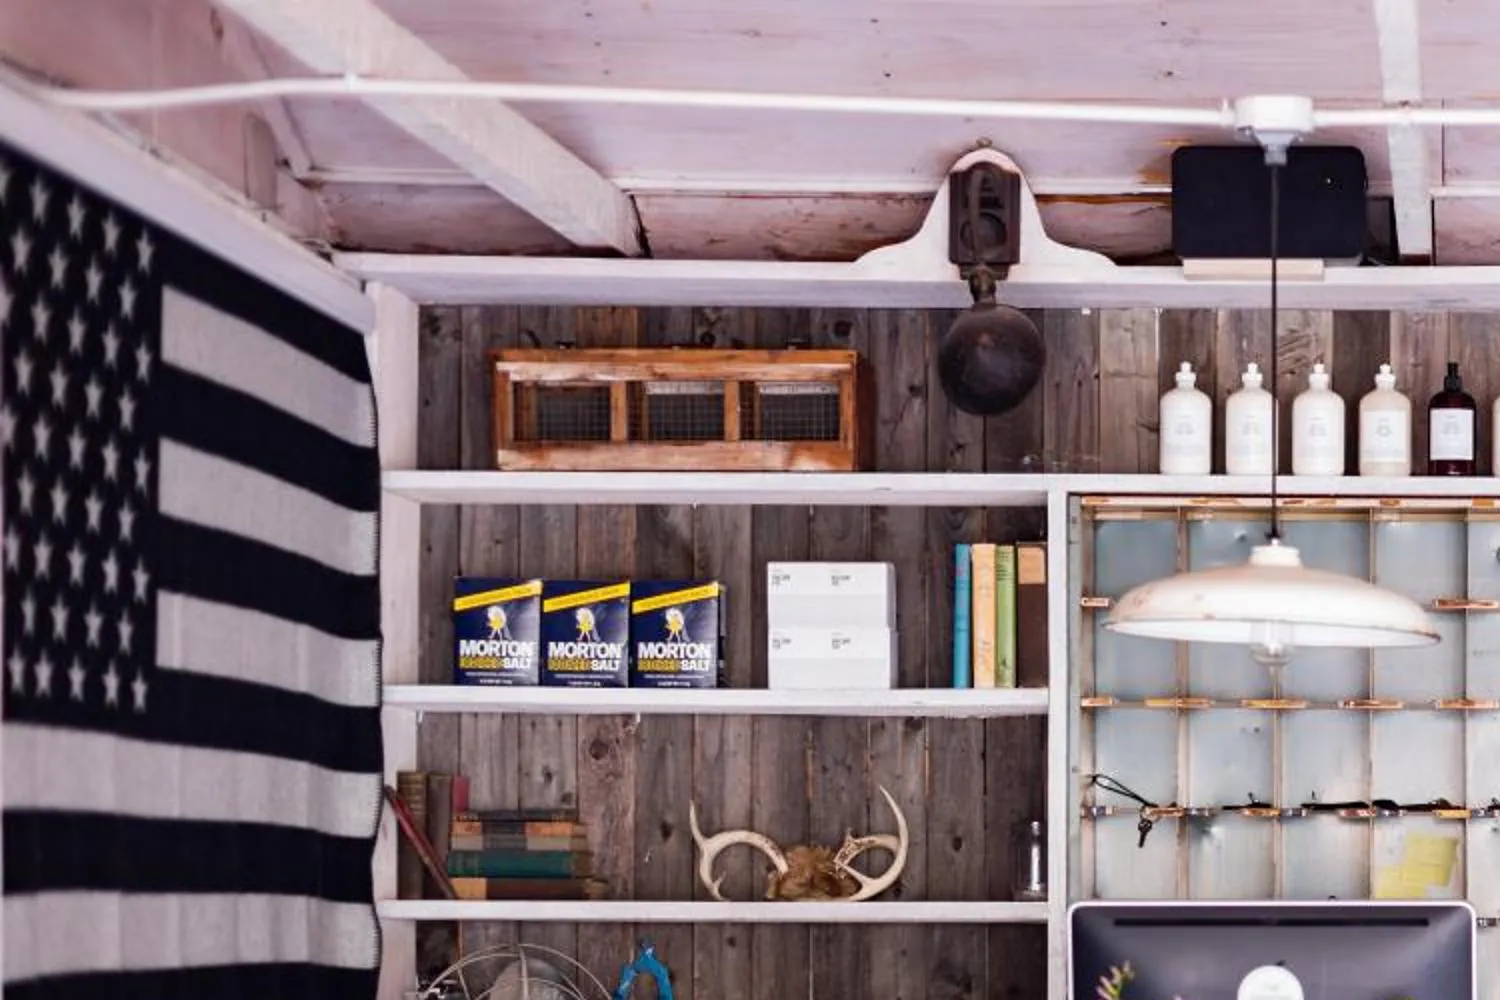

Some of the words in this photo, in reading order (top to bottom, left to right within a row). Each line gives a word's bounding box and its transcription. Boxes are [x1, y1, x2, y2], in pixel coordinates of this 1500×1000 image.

[460, 640, 535, 656] MORTON
[549, 642, 622, 658] MORTON
[638, 643, 711, 658] MORTON
[503, 658, 531, 668] SALT
[591, 660, 620, 670] SALT
[680, 660, 709, 670] SALT
